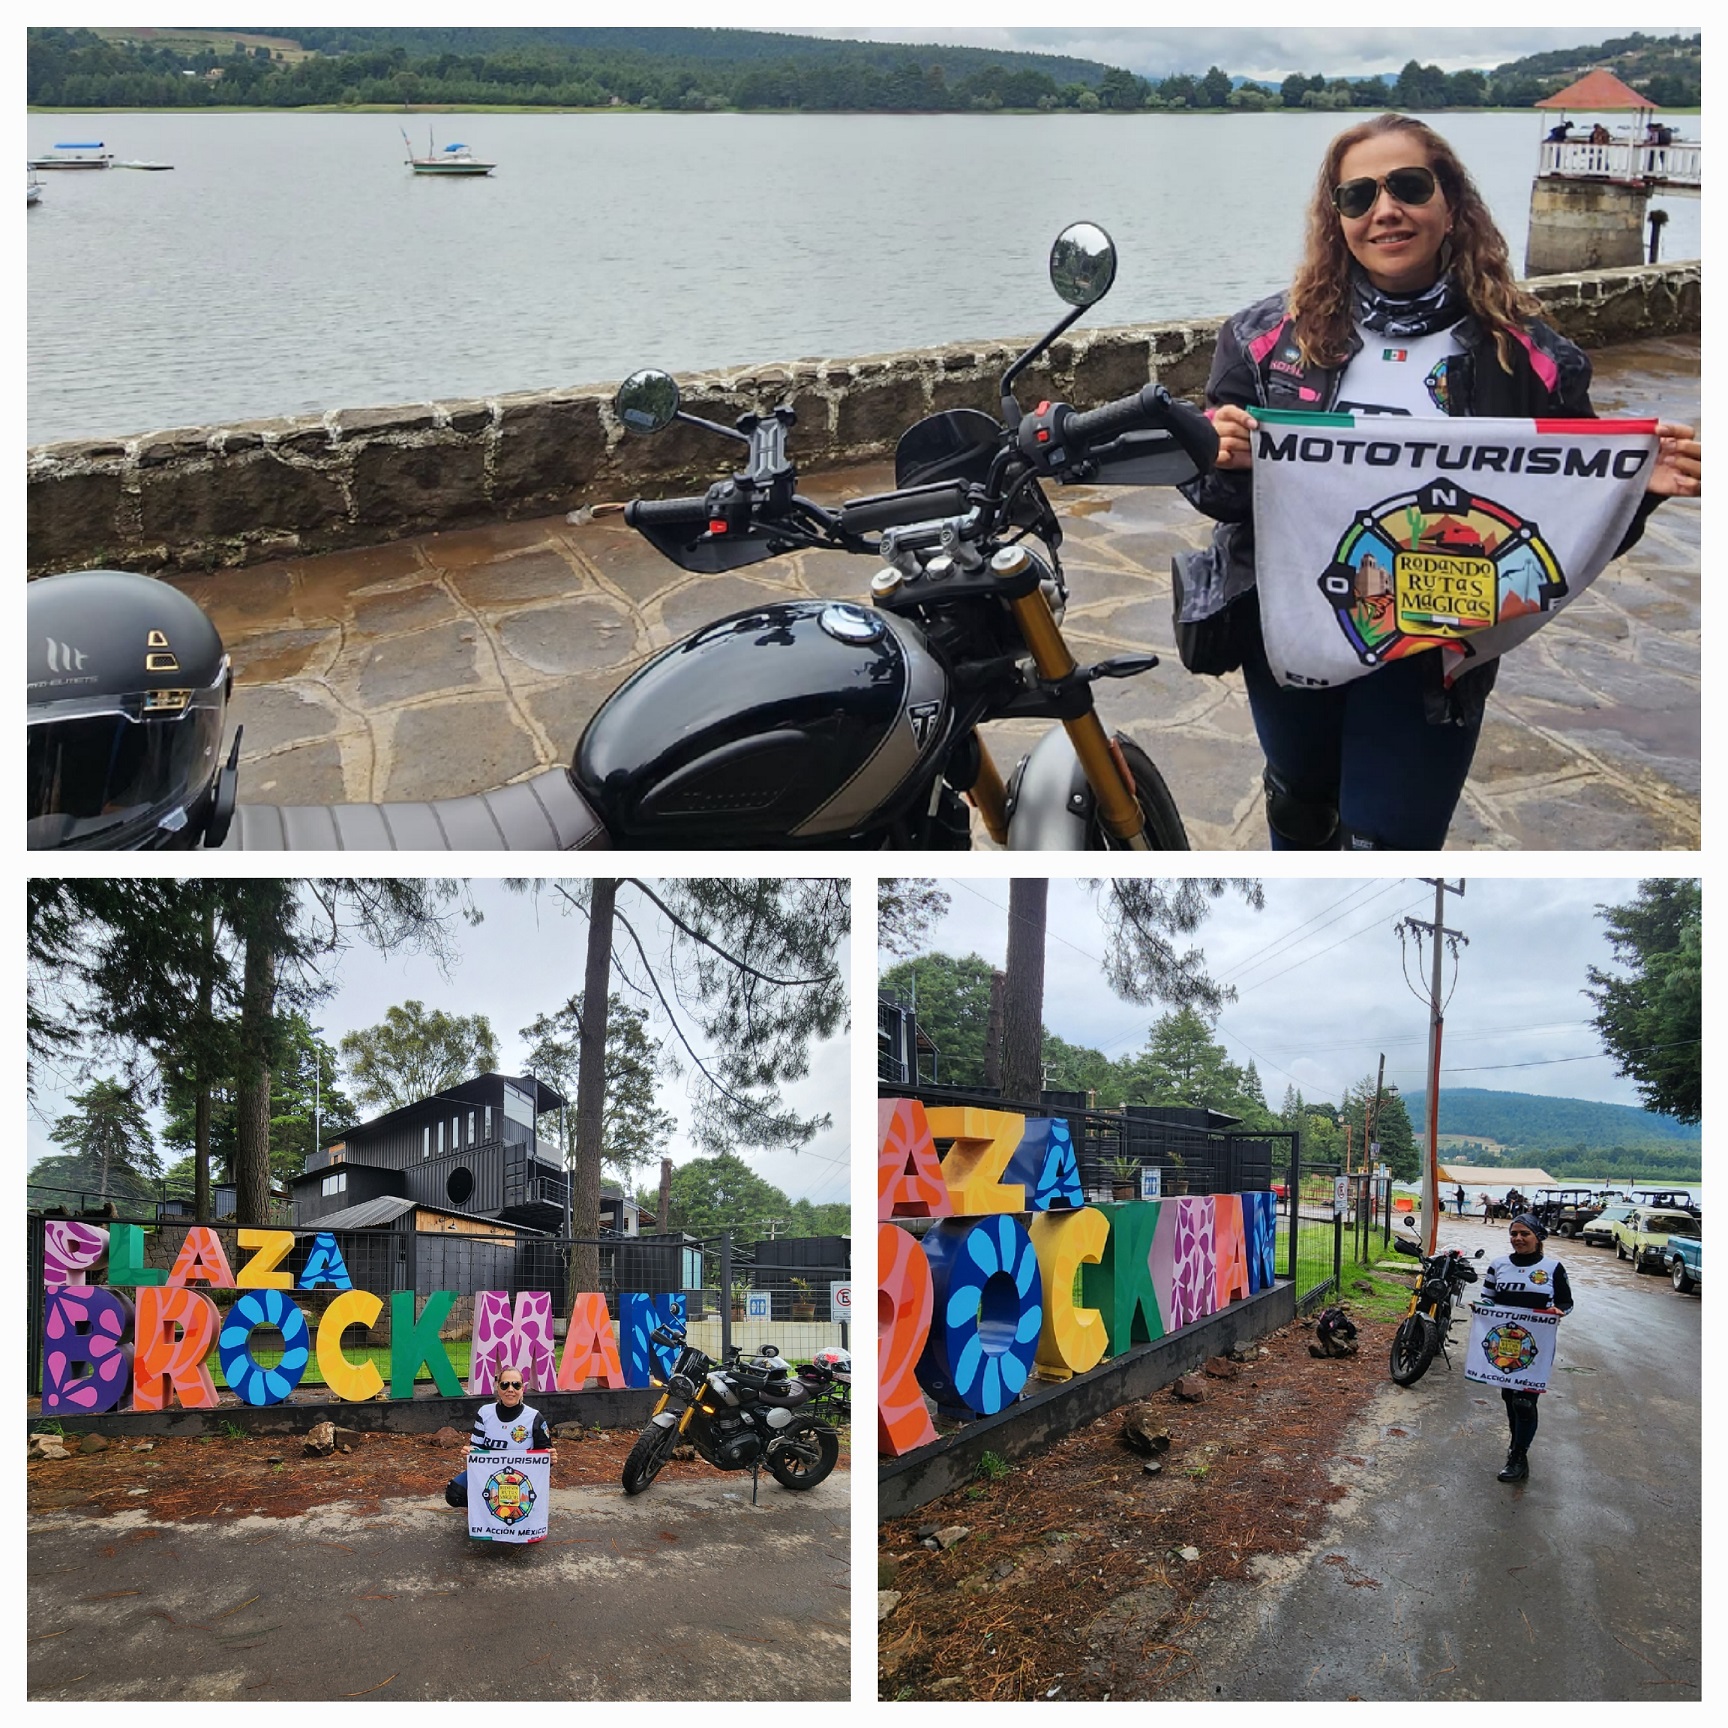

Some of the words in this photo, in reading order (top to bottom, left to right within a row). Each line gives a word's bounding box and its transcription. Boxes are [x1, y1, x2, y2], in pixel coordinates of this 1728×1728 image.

[1258, 431, 1650, 479] MOTOTURISMO
[1432, 488, 1457, 506] N
[1326, 576, 1348, 594] O
[44, 1220, 353, 1290] PLAZA
[1472, 1307, 1557, 1325] MOTOTURISMO
[42, 1286, 687, 1416] BROCKMAN
[1480, 1373, 1511, 1383] ACCIÓN
[1514, 1378, 1546, 1388] MÉXICO
[468, 1455, 550, 1465] MOTOTURISMO
[486, 1527, 515, 1536] ACCIÓN
[517, 1527, 547, 1537] MÉXICO
